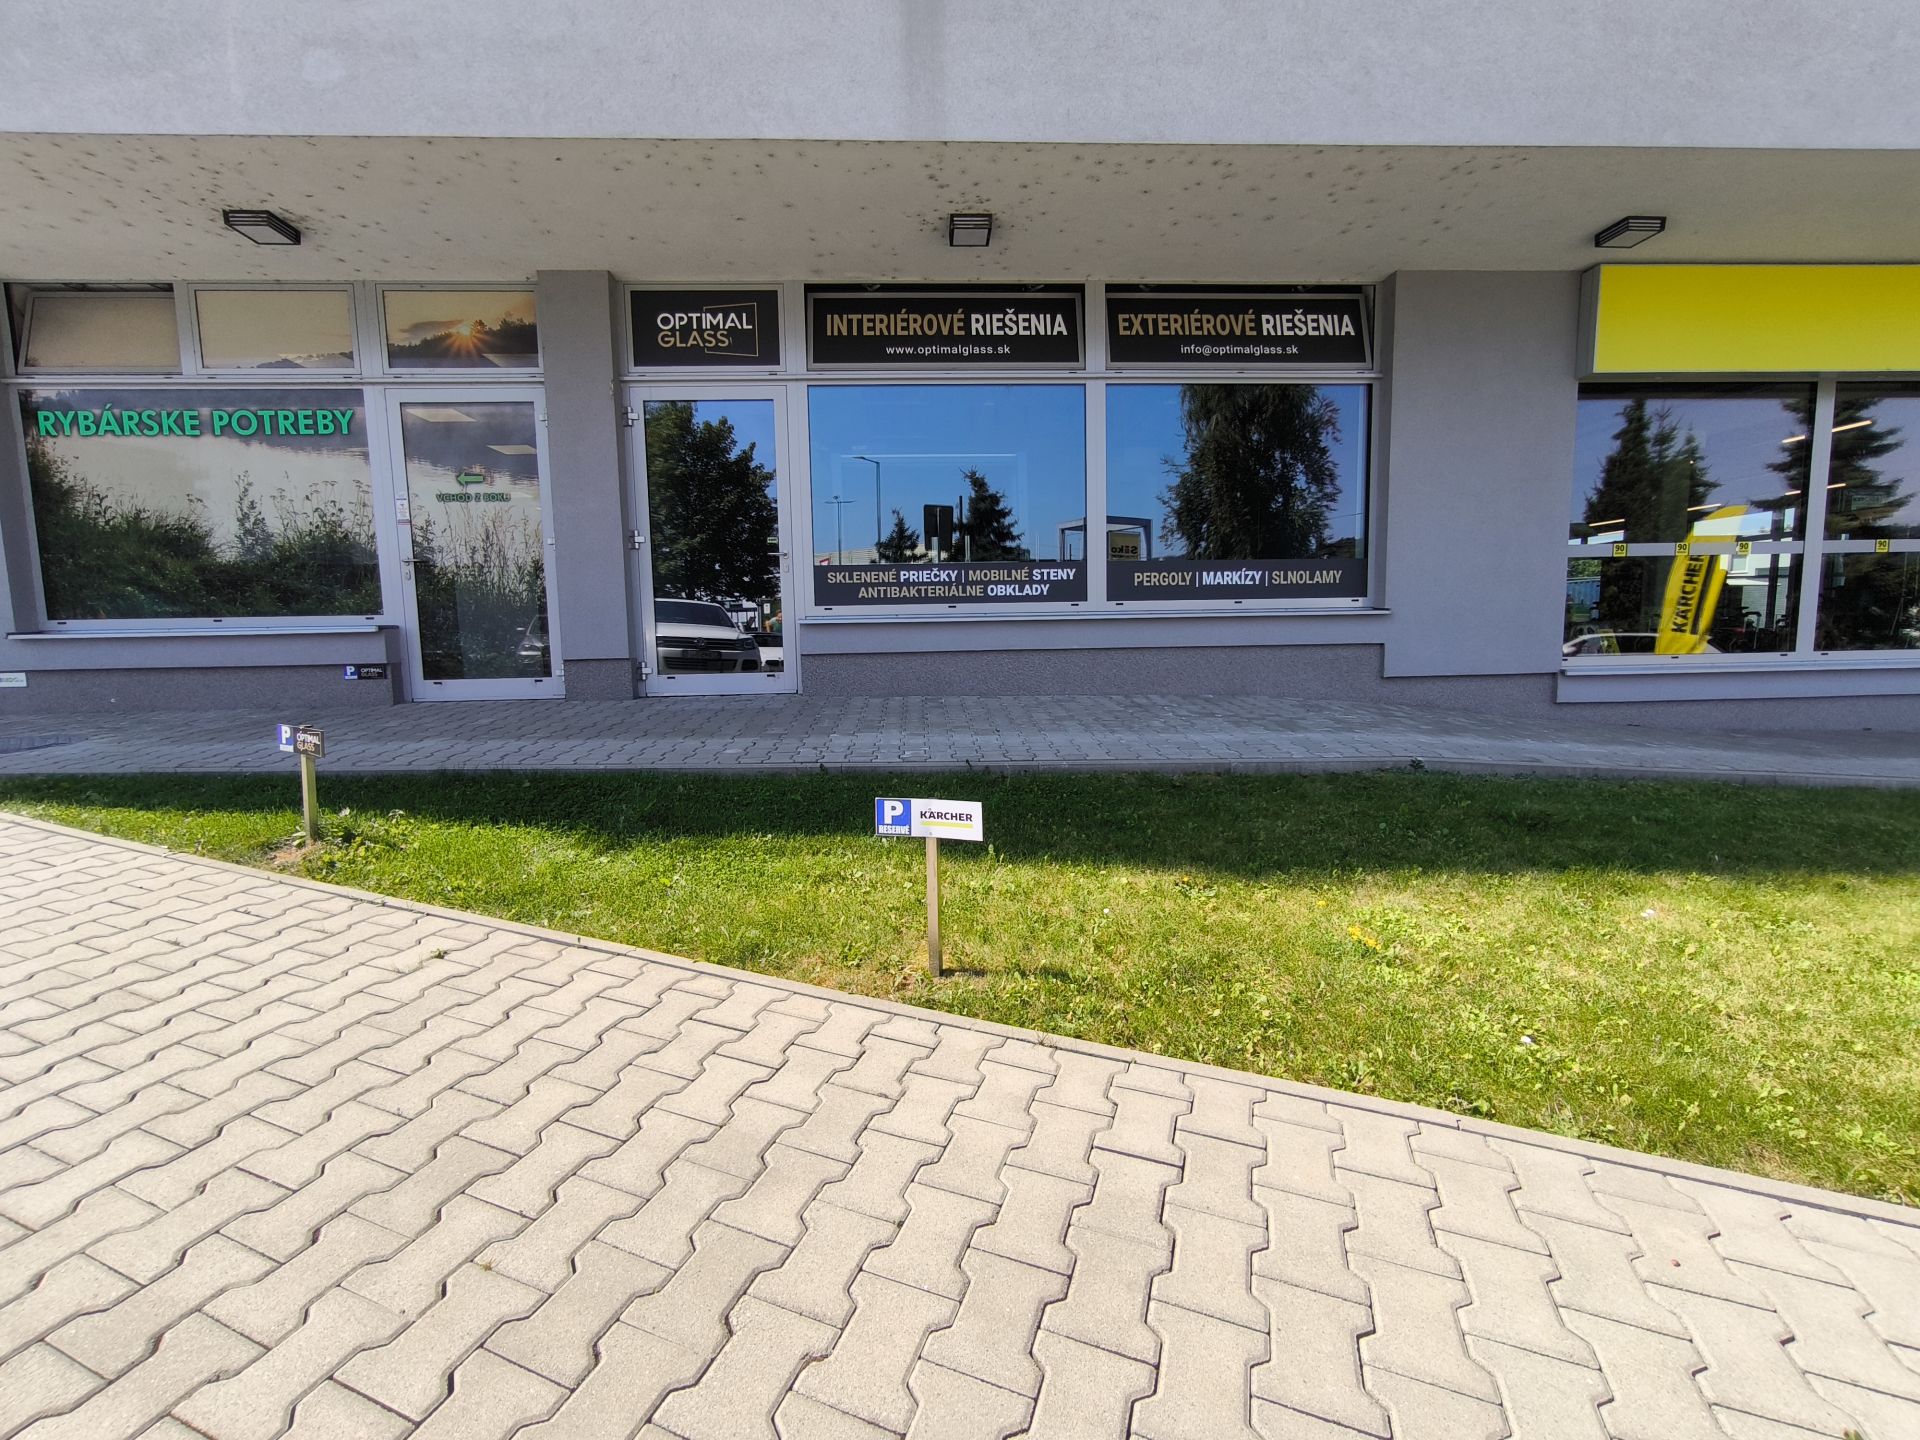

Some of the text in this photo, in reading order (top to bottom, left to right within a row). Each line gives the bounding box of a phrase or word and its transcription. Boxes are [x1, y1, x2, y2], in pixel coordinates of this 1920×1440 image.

[657, 312, 753, 330] OPTIMAL
[826, 308, 1068, 337] INTERIÉROVÉ RIEŠENIA
[1117, 309, 1355, 336] EXTERIÉROVÉ RIEŠENIA
[657, 331, 732, 348] GLASS
[885, 344, 1011, 357] www.optimalglass.sk
[1180, 344, 1299, 356] info@optimalglass.sk
[37, 404, 354, 437] RYBÁRSKE POTREBY
[435, 492, 511, 503] VCHOD Z BOKU
[1615, 544, 1625, 552] 90
[1677, 543, 1687, 551] 90
[1739, 542, 1749, 550] 90
[827, 566, 1076, 583] SKLENENÉ PRIEČKY MOBILNÉ STENY
[1133, 568, 1343, 586] PERGOLY MARKÍZY SLNOLAMY
[858, 583, 1050, 599] ANTIBAKTERIÁLNE OBKLADY
[346, 666, 355, 675] P
[281, 726, 290, 744] P
[883, 800, 904, 824] P
[919, 809, 973, 822] KÄRCHER
